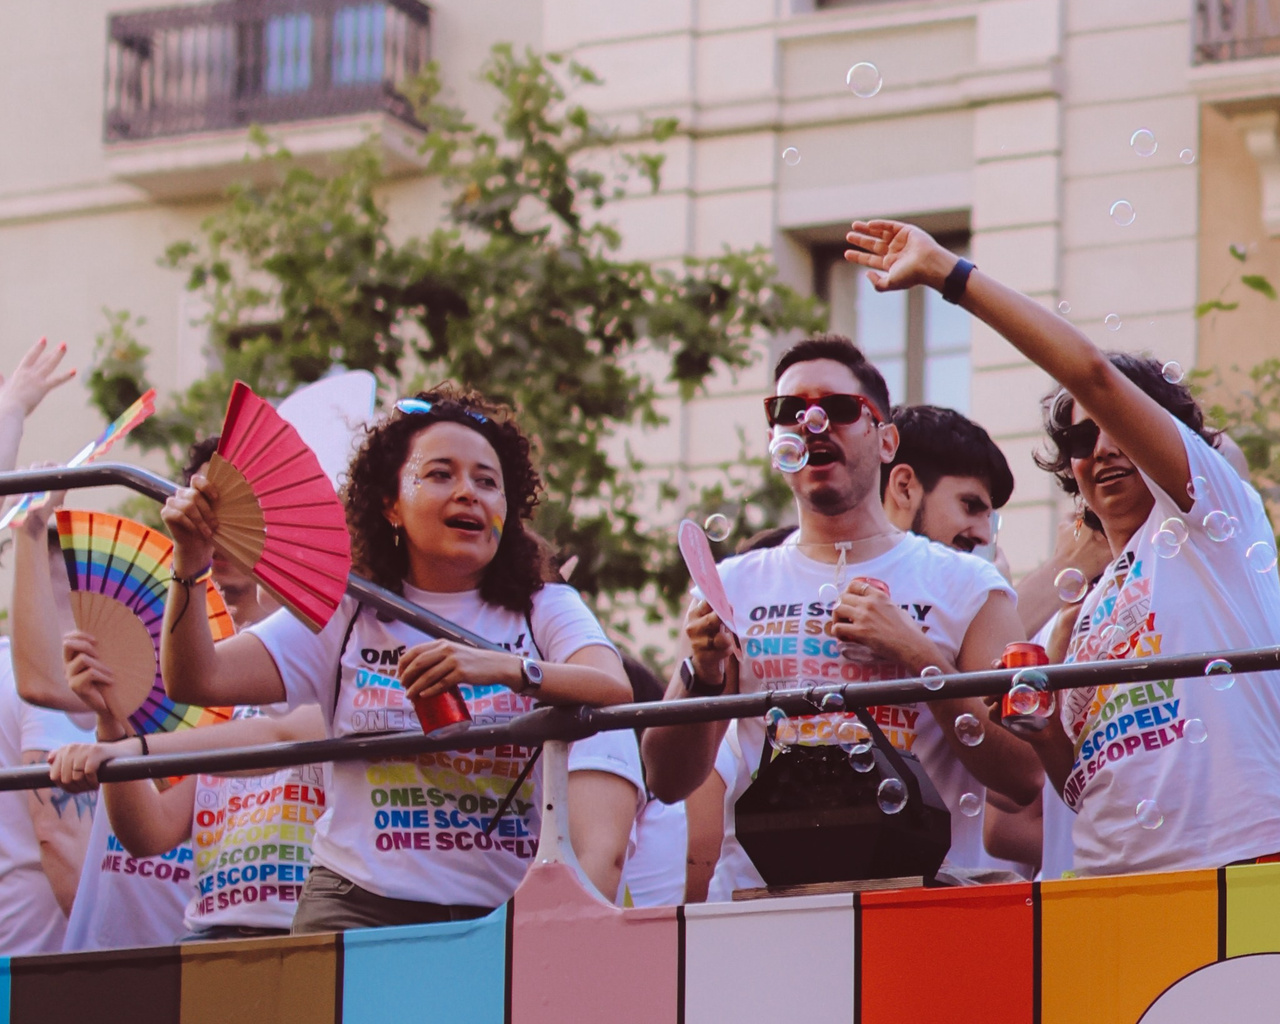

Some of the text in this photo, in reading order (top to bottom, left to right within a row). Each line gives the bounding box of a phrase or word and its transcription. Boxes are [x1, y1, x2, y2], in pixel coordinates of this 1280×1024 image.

[749, 603, 803, 622] ONE
[746, 620, 800, 636] ONE
[746, 637, 798, 658] ONE
[752, 658, 798, 680] ONE
[353, 687, 405, 709] ONE
[352, 708, 404, 732] ONE
[1081, 699, 1180, 761] SCOPELY
[1087, 719, 1186, 781] SCOPELY
[228, 783, 326, 813] SCOPELY
[371, 788, 427, 807] ONE
[375, 809, 429, 830] ONE
[376, 832, 430, 852] ONE
[218, 844, 314, 868] SCOPEL
[124, 857, 190, 883] SCOP
[217, 864, 309, 889] SCOPEL
